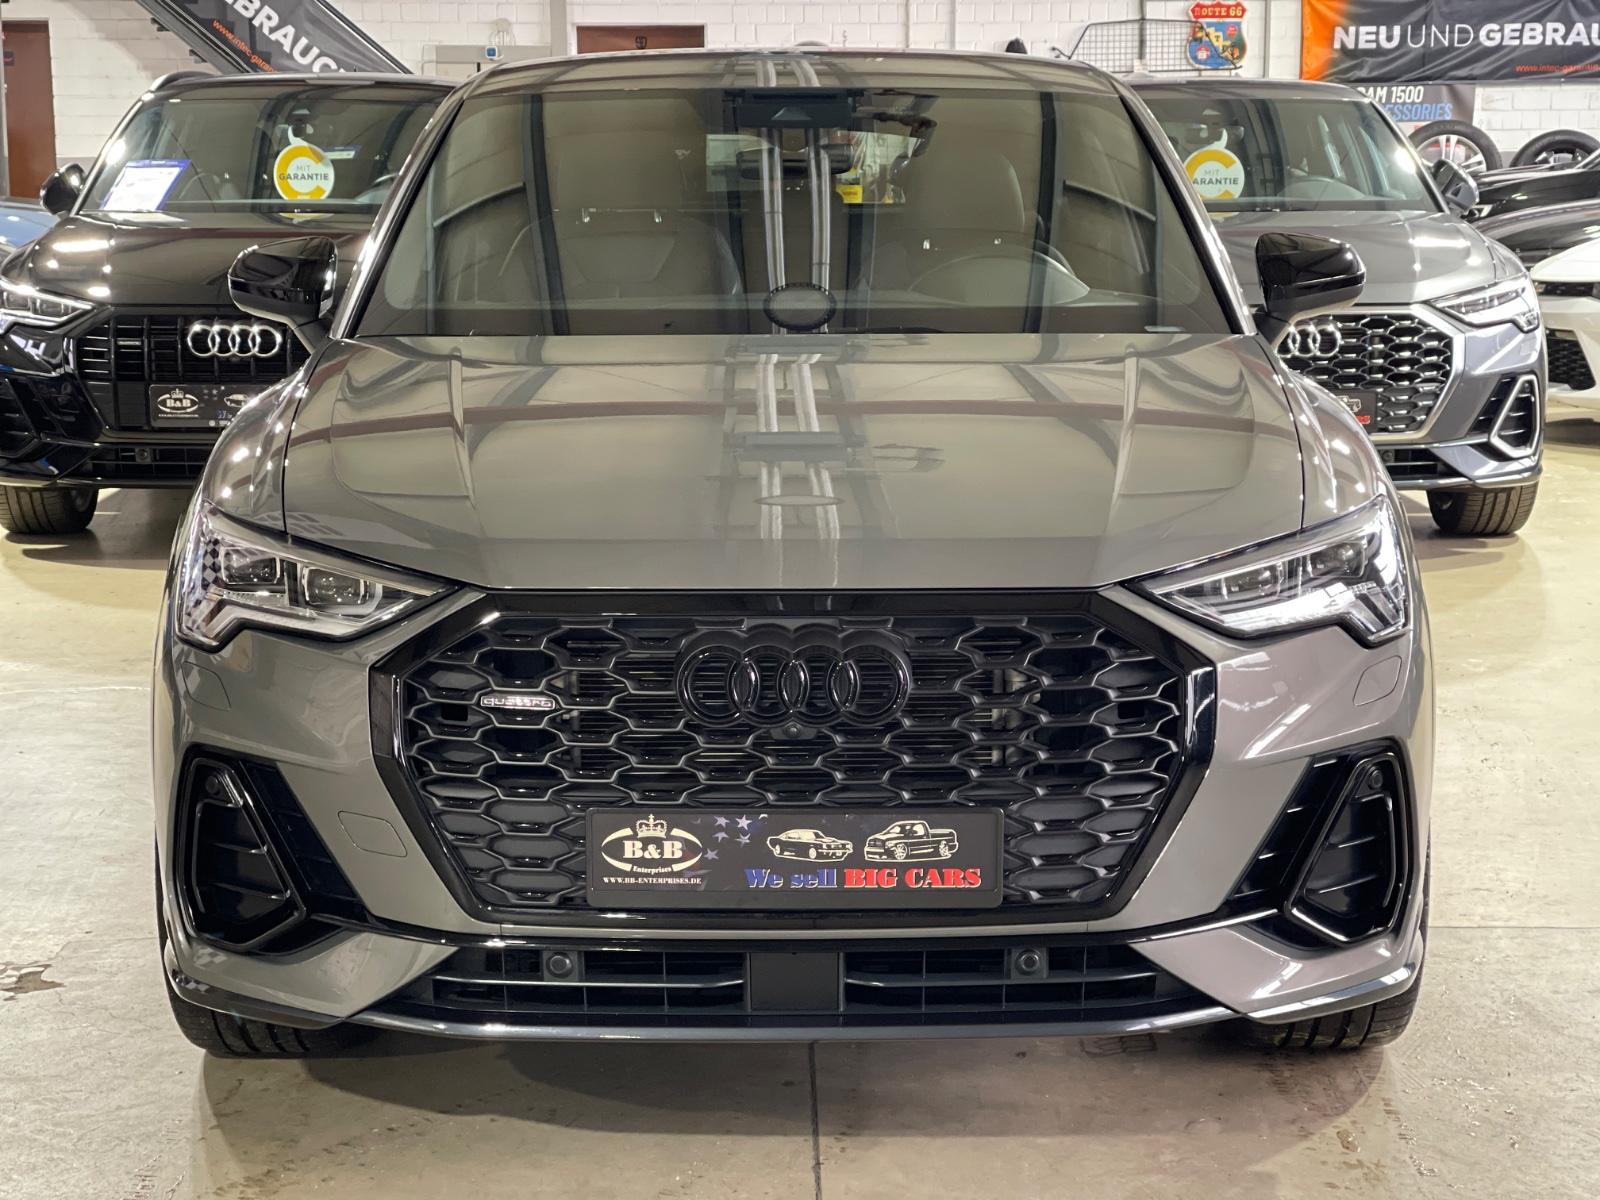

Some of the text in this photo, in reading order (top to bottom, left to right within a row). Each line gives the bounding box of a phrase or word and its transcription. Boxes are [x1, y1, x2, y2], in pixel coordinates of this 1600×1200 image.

[1194, 6, 1243, 16] ROUTE 66
[225, 0, 346, 73] BRAUC
[1333, 25, 1401, 49] NEU
[1407, 24, 1474, 48] UND
[1391, 85, 1425, 103] 1500
[279, 172, 329, 181] GARANTIE
[1192, 177, 1239, 185] ARANTIE
[166, 398, 191, 408] B&B
[483, 697, 552, 707] quattro
[622, 840, 683, 859] B&B
[632, 865, 673, 875] Enterprises
[602, 877, 702, 885] WWW.BB-ENTERPRISES.DE
[744, 868, 981, 888] We sell BIG CARS
